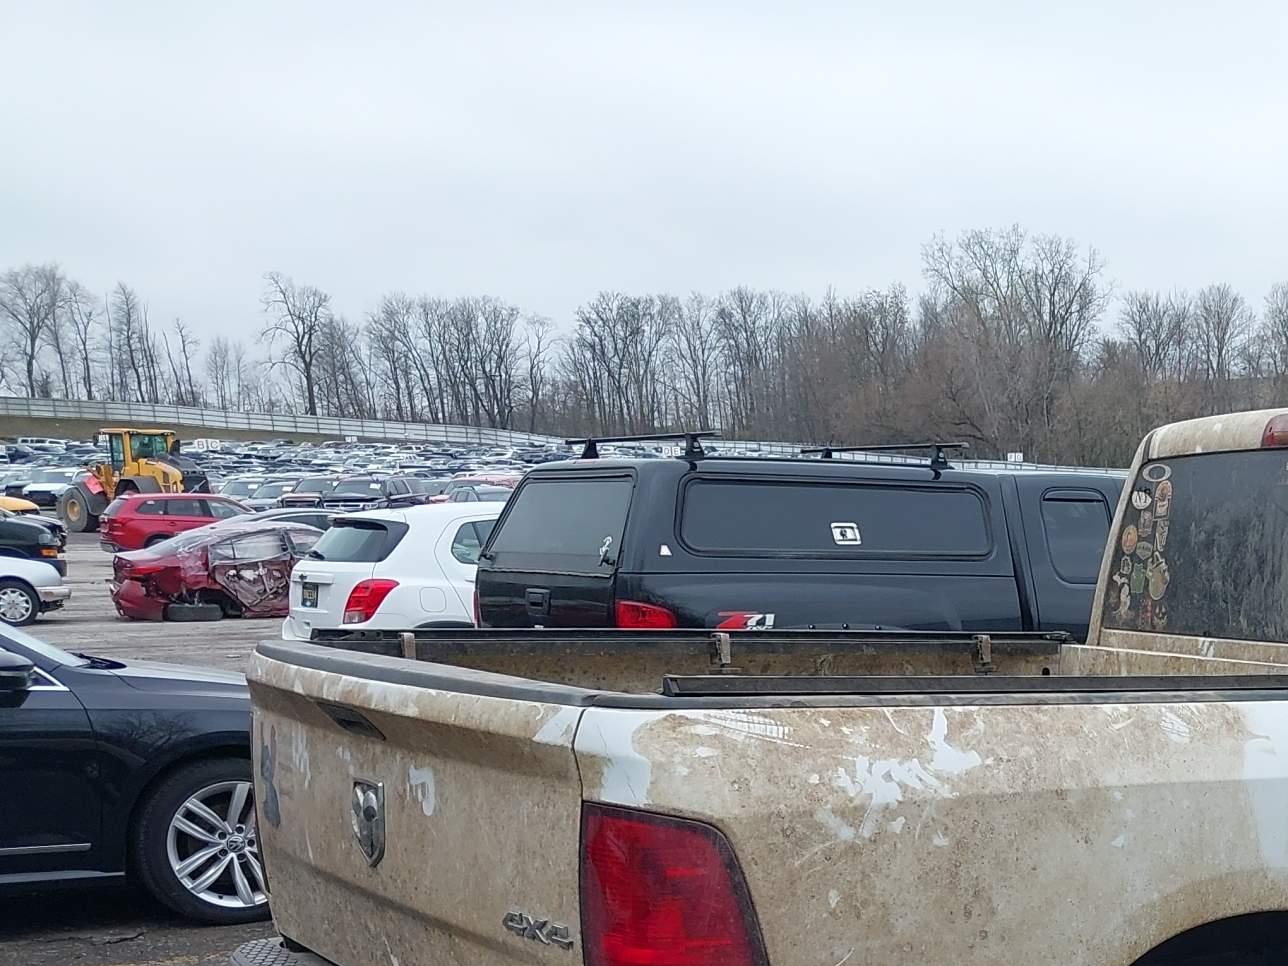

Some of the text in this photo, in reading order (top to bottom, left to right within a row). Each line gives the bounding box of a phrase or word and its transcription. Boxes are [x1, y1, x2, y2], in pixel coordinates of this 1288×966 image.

[197, 440, 218, 449] B C
[716, 611, 775, 631] Z71
